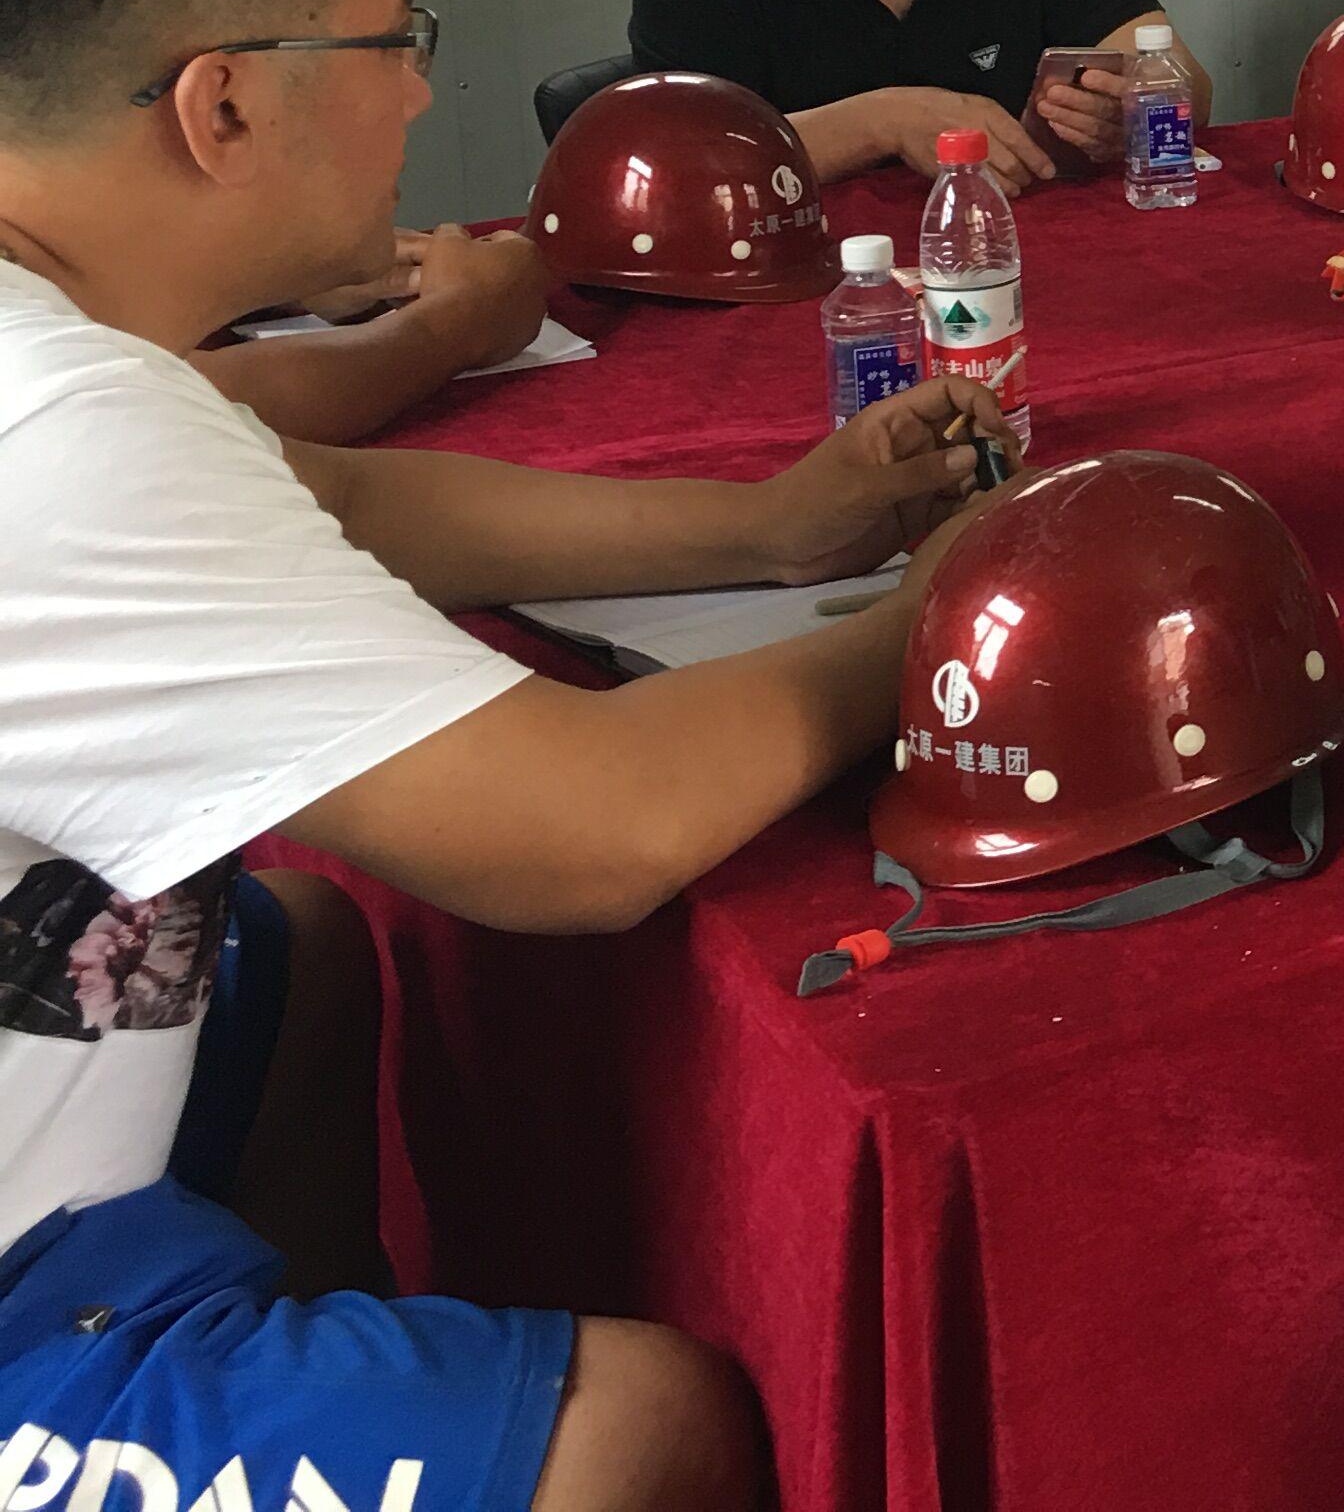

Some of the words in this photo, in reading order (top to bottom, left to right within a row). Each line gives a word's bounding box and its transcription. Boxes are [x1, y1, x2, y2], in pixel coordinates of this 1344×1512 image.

[906, 724, 1029, 776] 太原一建集团
